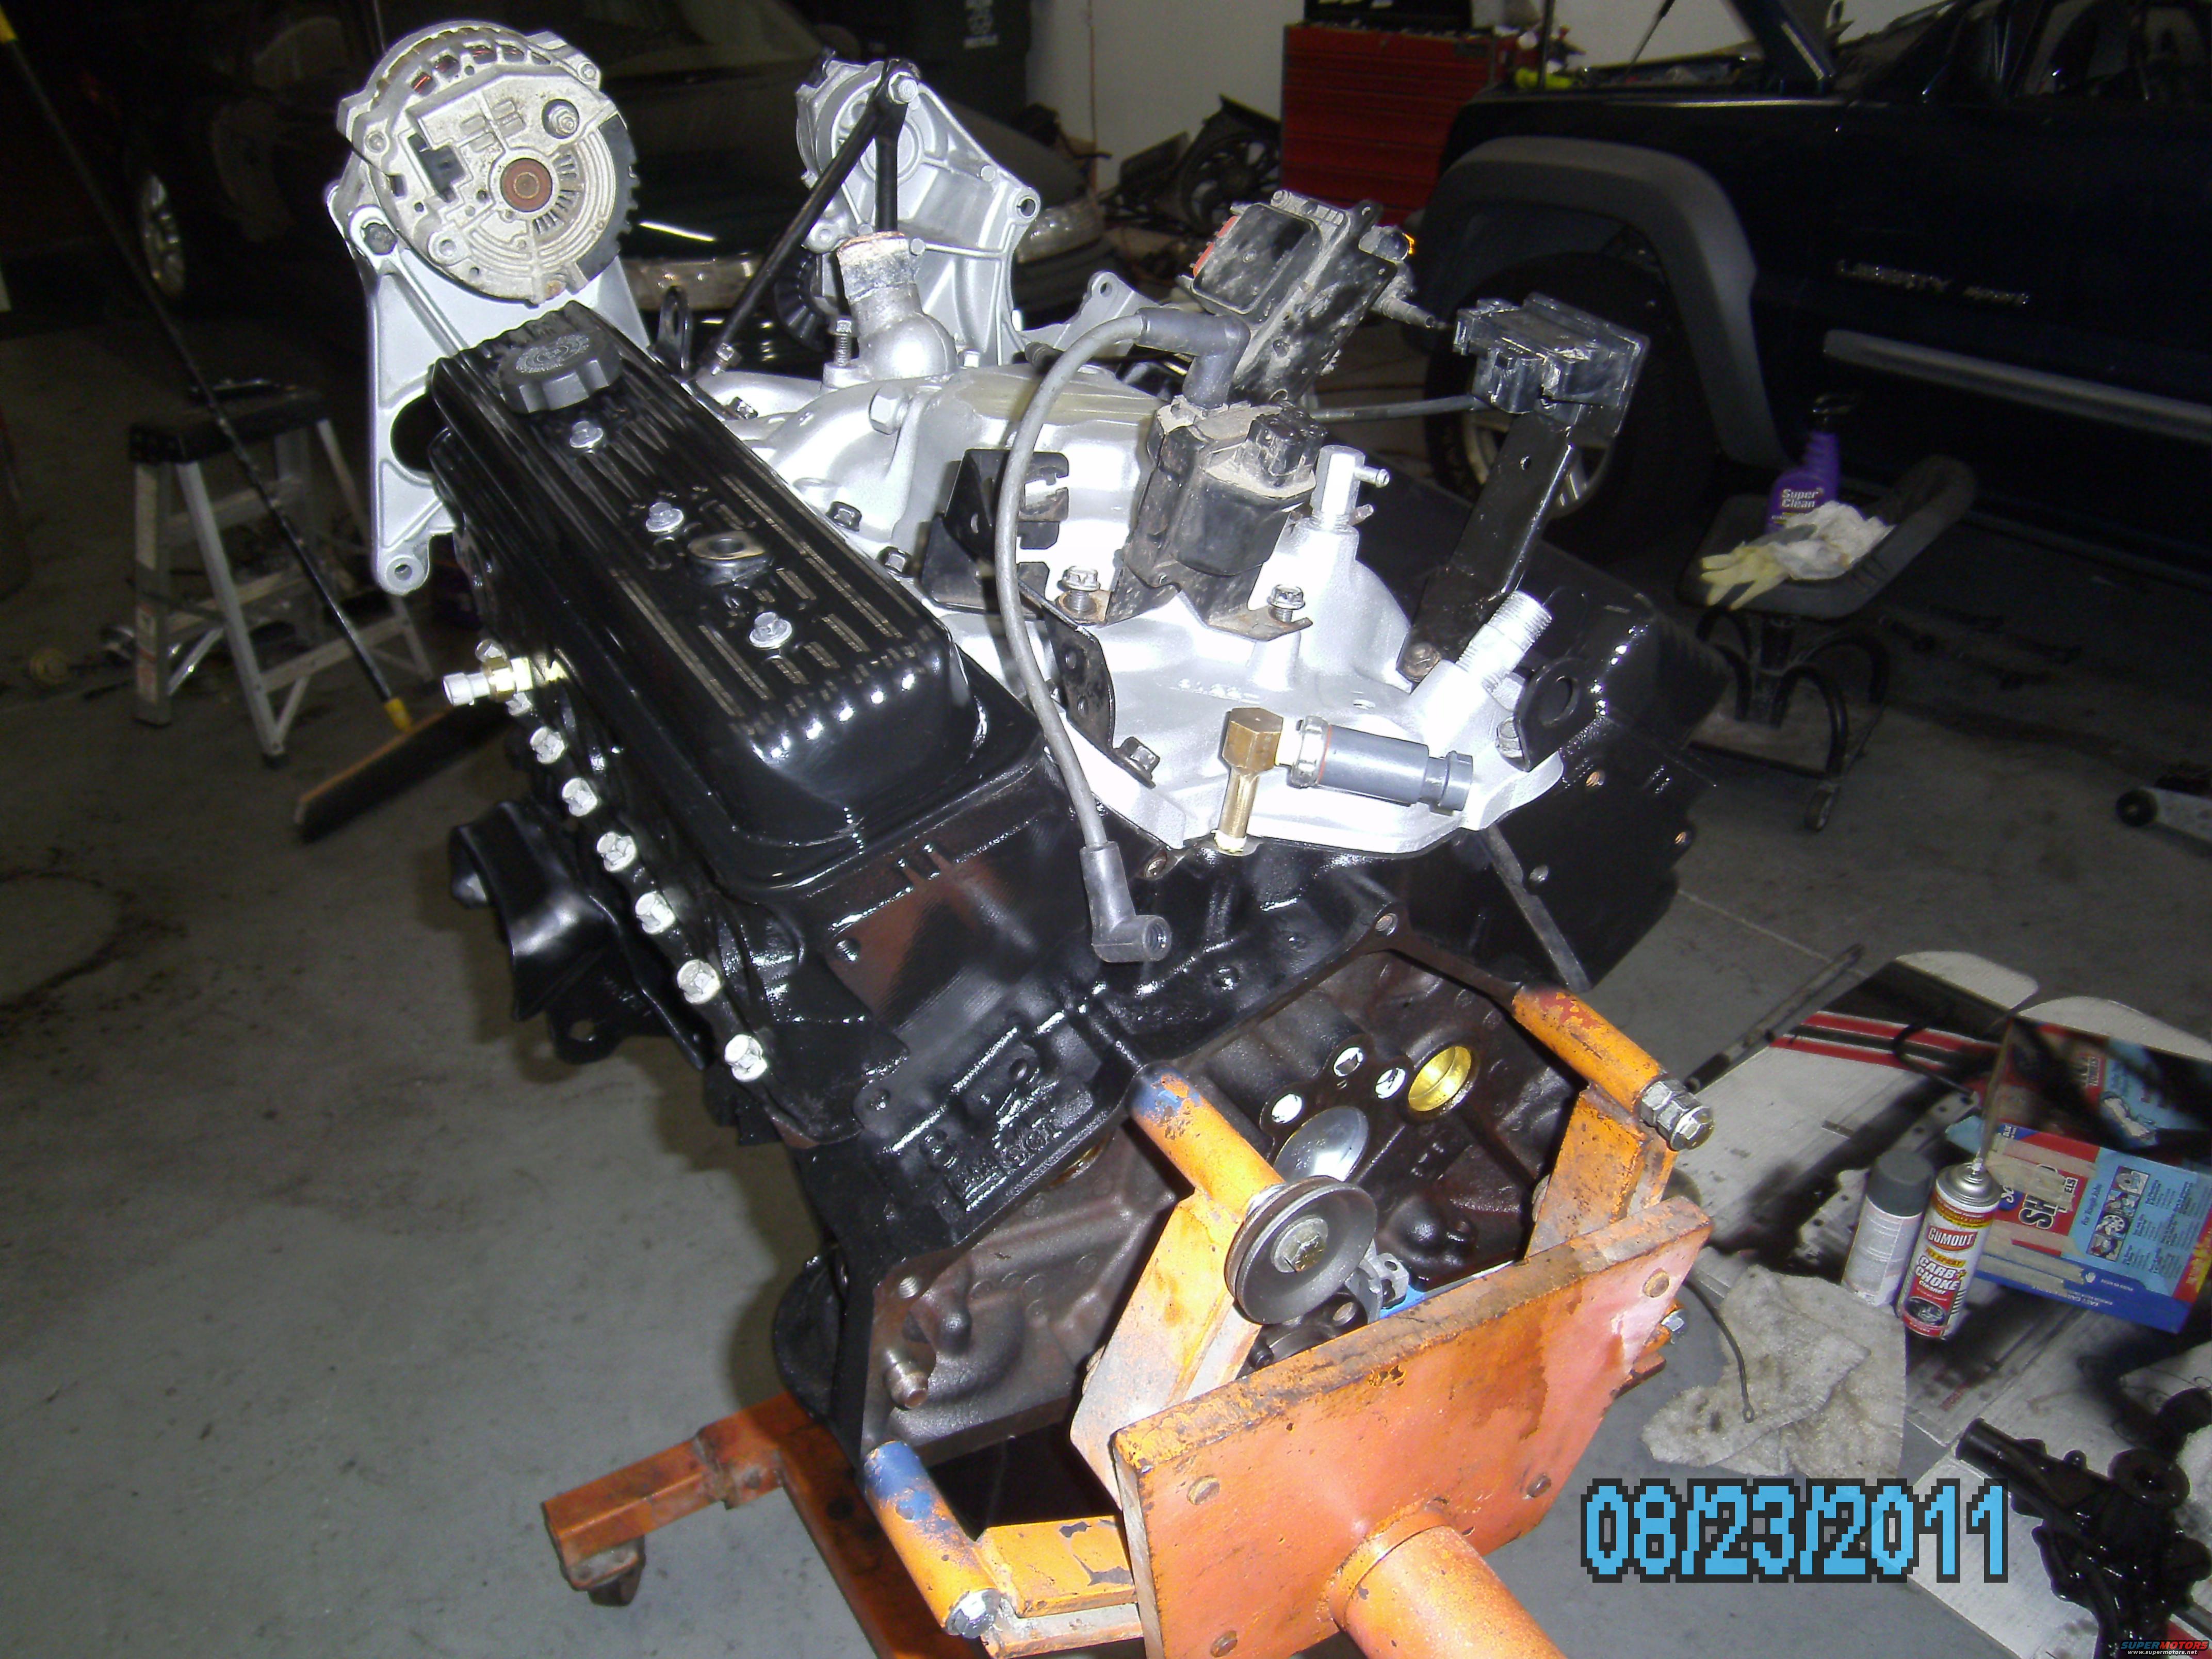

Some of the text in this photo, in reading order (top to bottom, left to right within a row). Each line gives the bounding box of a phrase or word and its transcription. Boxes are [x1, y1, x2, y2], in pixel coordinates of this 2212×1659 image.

[1782, 489, 1818, 500] Super
[1782, 498, 1815, 508] Clean
[1928, 1227, 1974, 1246] GUMOUT
[1918, 1256, 1957, 1279] CARB
[1915, 1265, 1961, 1291] CHOKE
